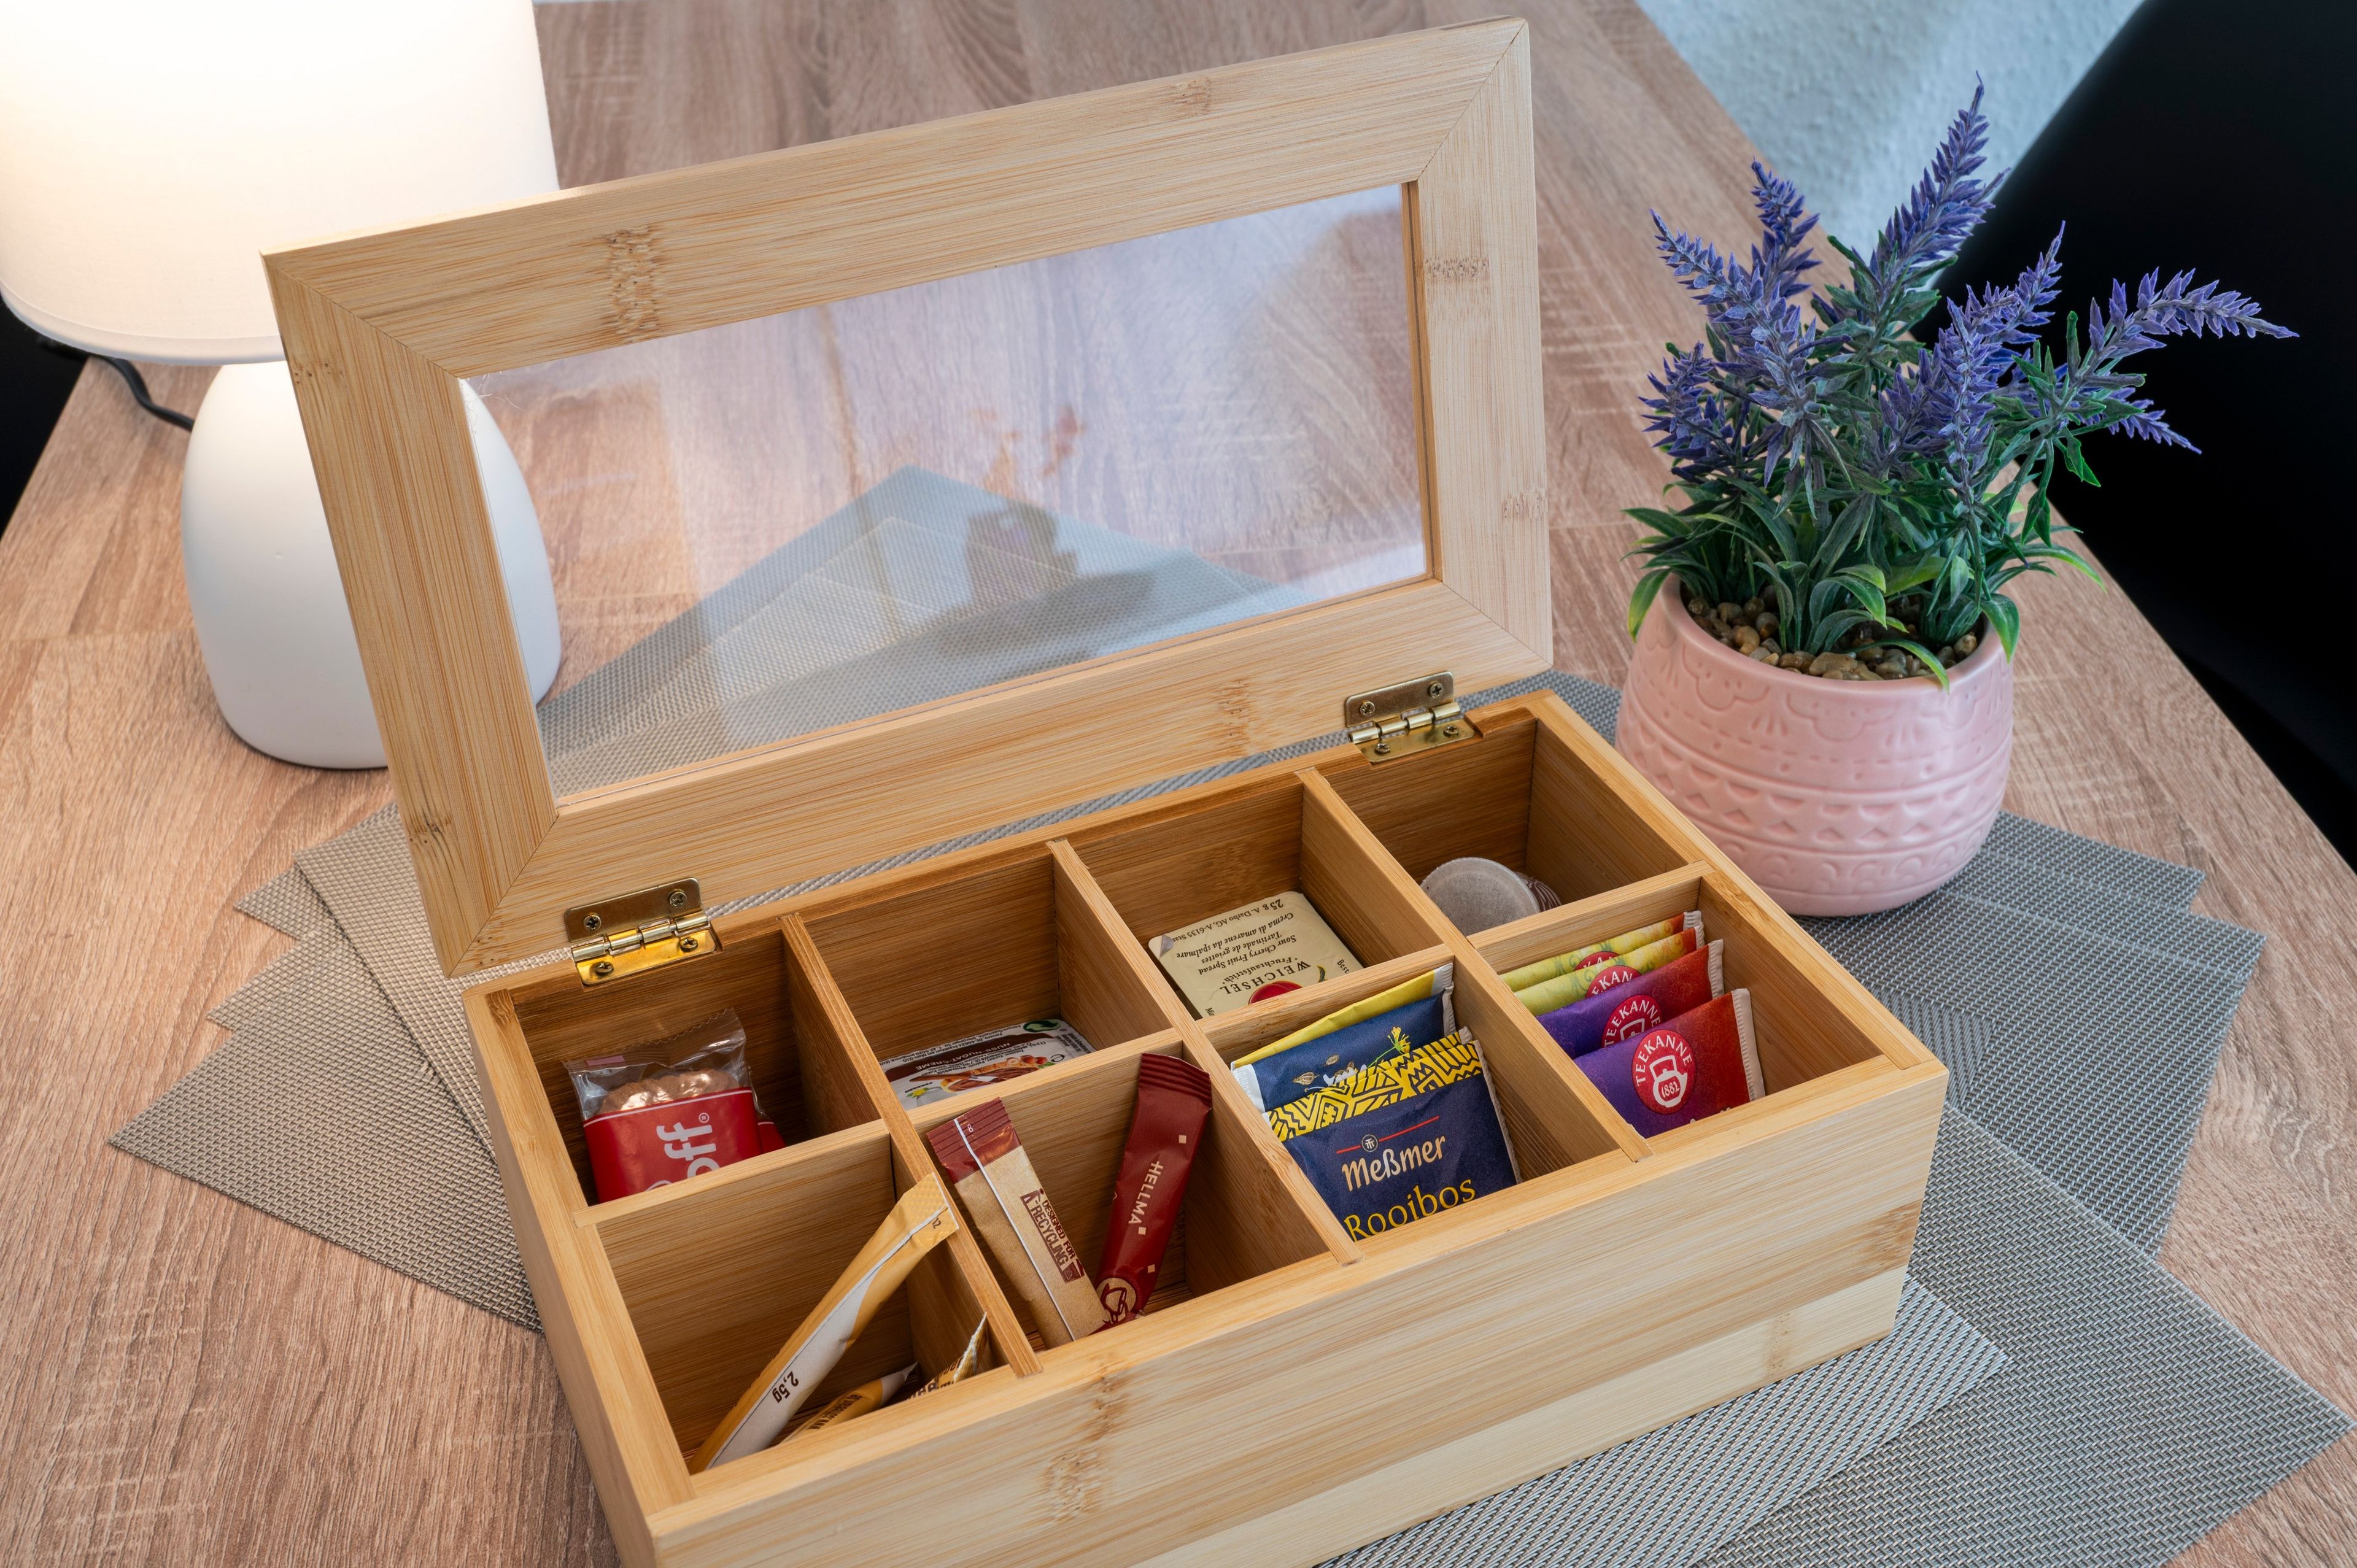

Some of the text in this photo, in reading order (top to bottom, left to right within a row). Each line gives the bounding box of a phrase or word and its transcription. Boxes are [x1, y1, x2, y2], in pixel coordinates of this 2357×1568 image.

[1228, 910, 1251, 922] Darbo
[1269, 898, 1283, 910] 25
[1186, 923, 1212, 938] A-6135
[1212, 918, 1228, 929] AG,
[1258, 925, 1268, 934] di
[1268, 912, 1293, 928] Crema
[1176, 943, 1211, 957] spalmare
[1201, 931, 1282, 964] Tartinade de griottes
[1223, 929, 1257, 943] amarene
[1198, 935, 1296, 975] Sour Cherry Fruit Spread
[1337, 959, 1349, 973] Best
[1220, 961, 1311, 993] WEICHSEL
[1224, 957, 1292, 983] Fruchtaufstrich
[1604, 1000, 1661, 1048] TEEKANNE
[1636, 1035, 1692, 1086] TEEKANNE
[1662, 1081, 1680, 1097] 1882
[1342, 1135, 1446, 1192] Meßmer
[1128, 1161, 1164, 1224] HELLMA
[1344, 1179, 1476, 1242] Rooibos
[1029, 1204, 1070, 1265] RECYCLING
[1041, 1200, 1066, 1239] DESIGNED
[1062, 1240, 1077, 1259] FOR
[772, 1370, 799, 1404] 2,5g
